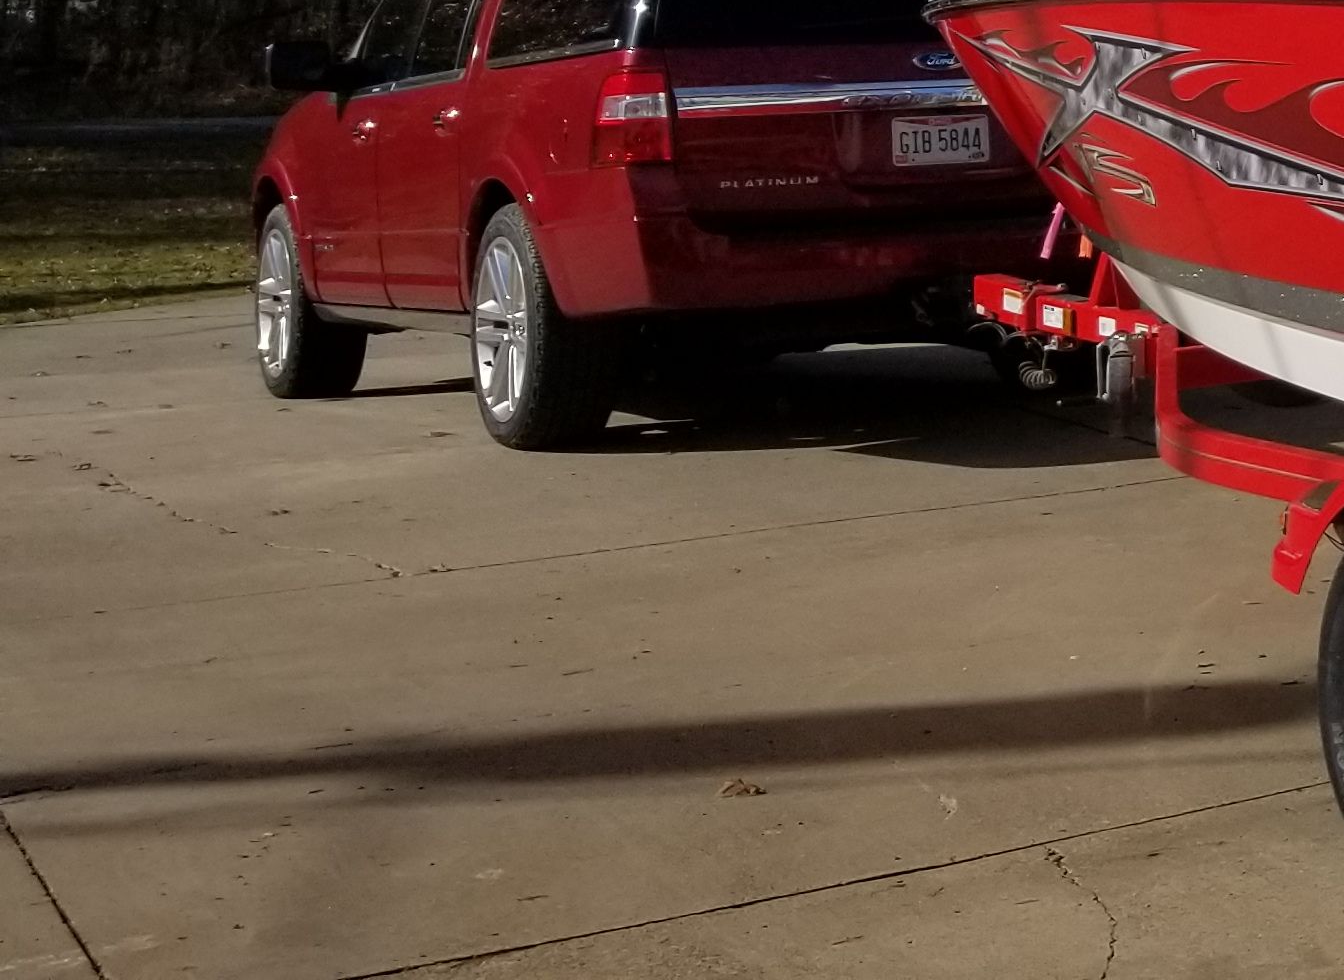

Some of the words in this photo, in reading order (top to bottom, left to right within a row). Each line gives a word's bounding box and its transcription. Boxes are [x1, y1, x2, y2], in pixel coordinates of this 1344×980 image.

[926, 52, 956, 66] Ford
[900, 130, 932, 154] GIB
[938, 127, 982, 152] 5844
[720, 176, 819, 189] PLATINUM
